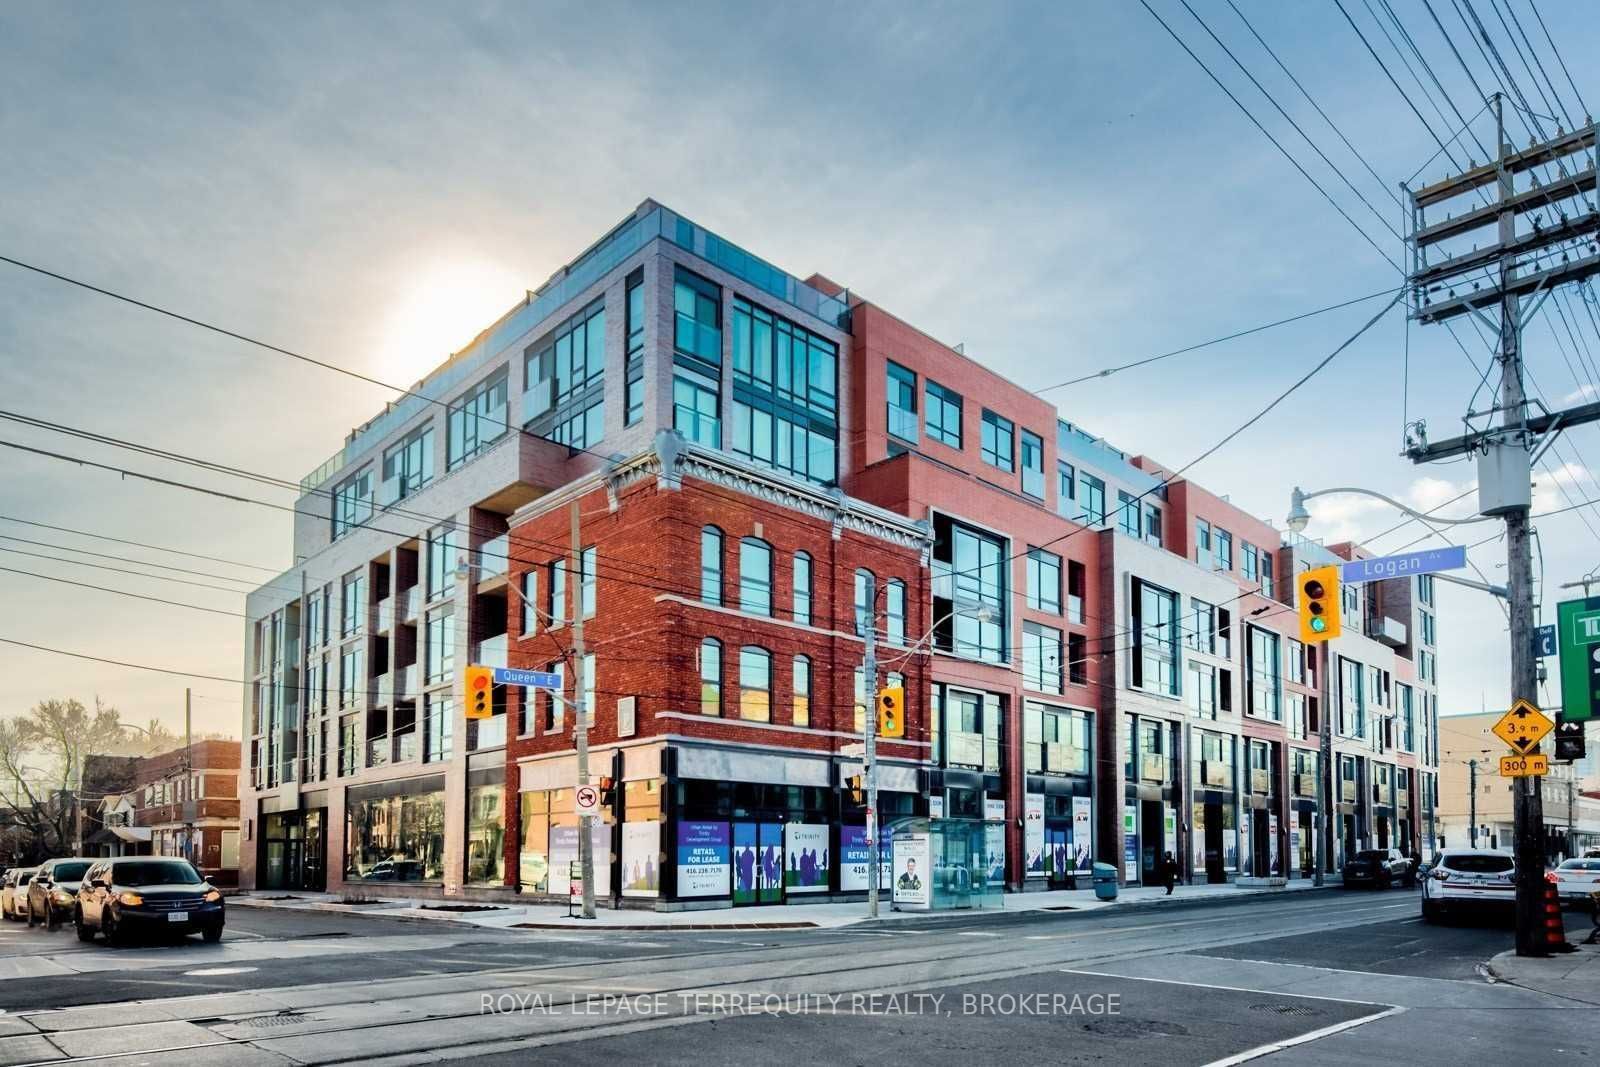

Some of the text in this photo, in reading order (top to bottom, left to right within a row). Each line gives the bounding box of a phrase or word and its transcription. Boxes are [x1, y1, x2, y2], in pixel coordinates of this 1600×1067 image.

[1364, 558, 1420, 575] Logan
[503, 670, 553, 685] Queen E
[1507, 723, 1525, 734] 3.9
[1504, 761, 1527, 771] 300
[687, 856, 721, 864] FOR LEASE
